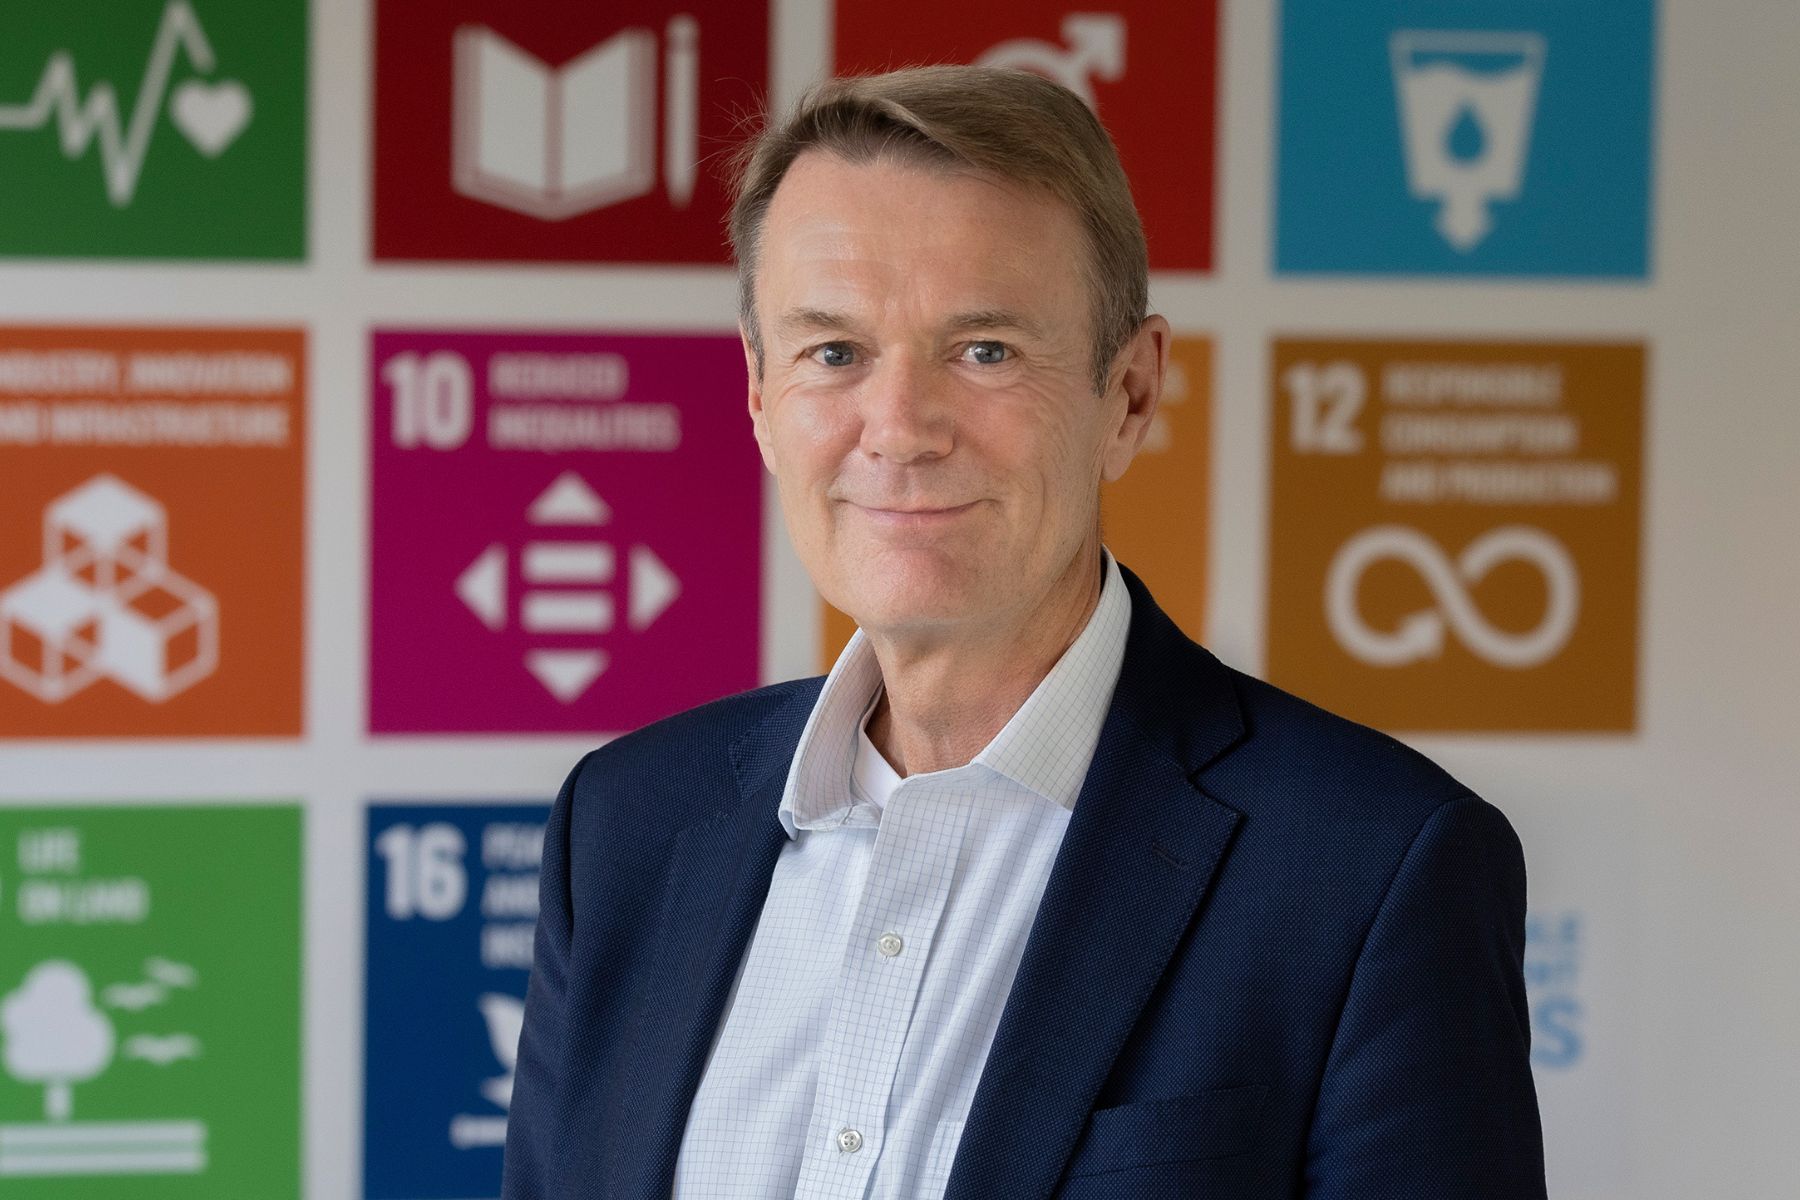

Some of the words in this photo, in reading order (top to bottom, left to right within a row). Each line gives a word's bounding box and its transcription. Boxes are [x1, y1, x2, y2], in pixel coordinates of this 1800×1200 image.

[381, 351, 474, 450] 10
[1282, 361, 1367, 454] 12
[376, 823, 467, 920] 16
